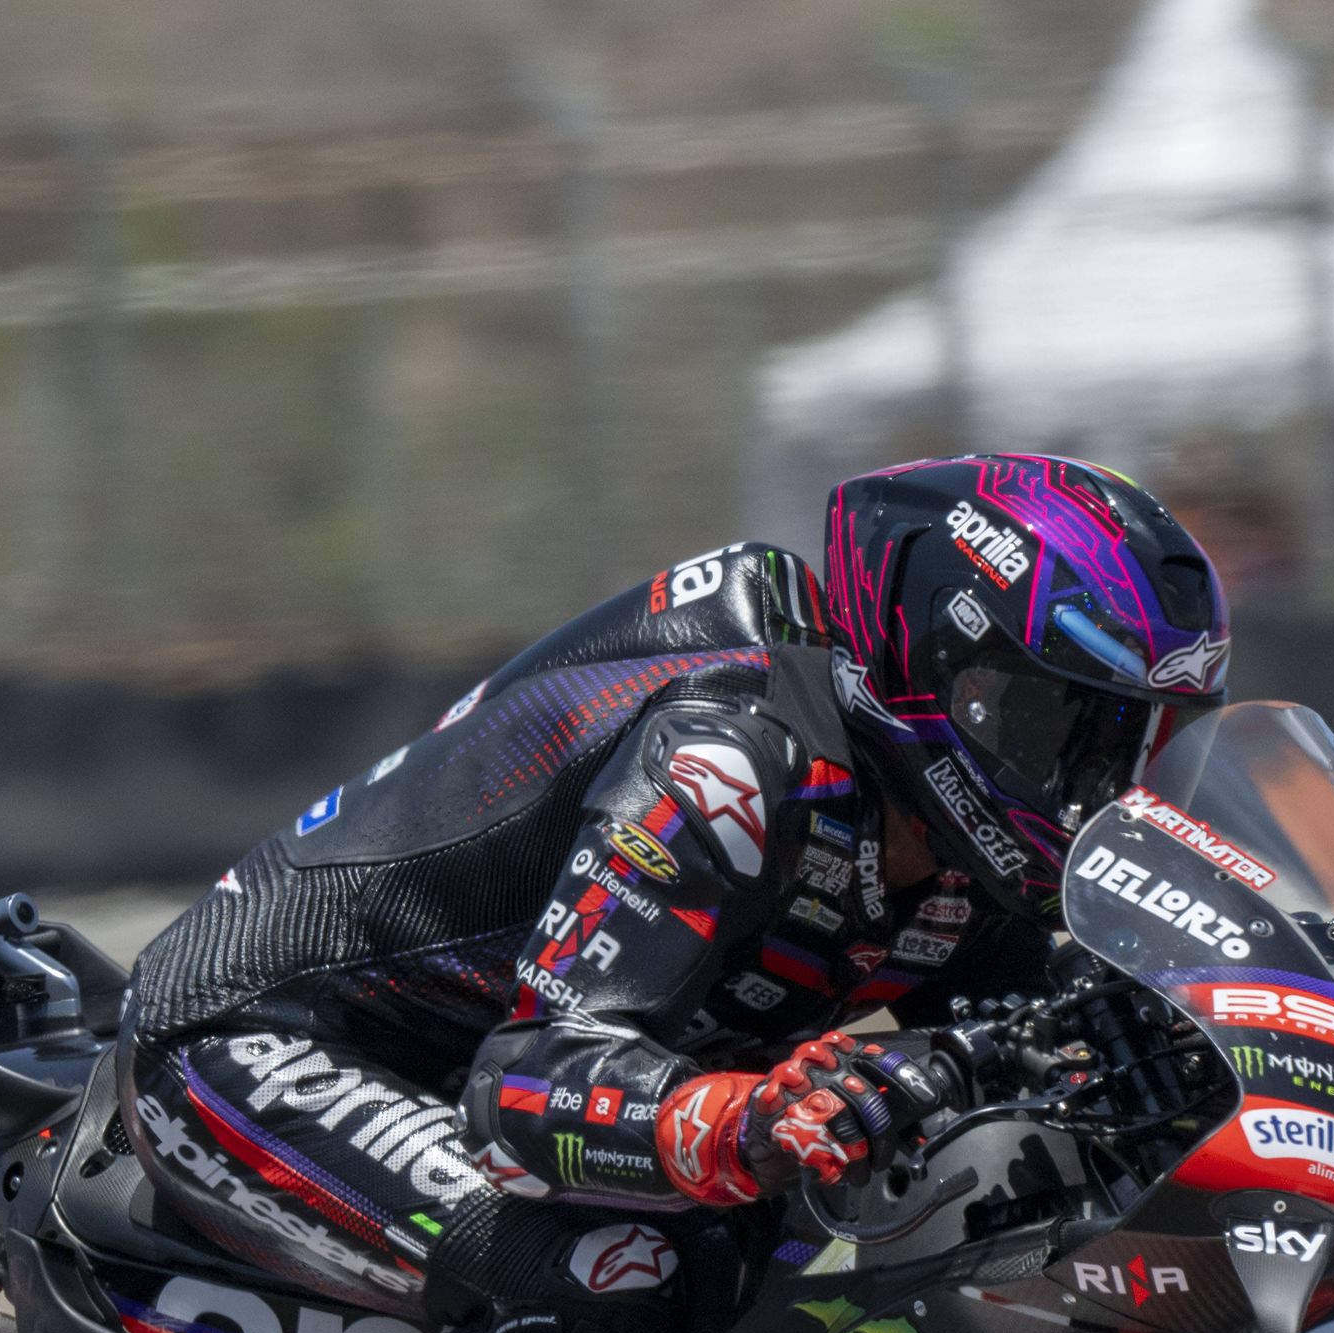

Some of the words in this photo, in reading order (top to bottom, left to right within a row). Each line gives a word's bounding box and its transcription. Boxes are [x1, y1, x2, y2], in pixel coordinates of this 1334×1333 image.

[946, 500, 1029, 584] aprilia
[955, 537, 1010, 592] RACING
[954, 600, 984, 633] 100%
[588, 860, 661, 923] Lifenet.it
[855, 839, 887, 921] aprilia
[1075, 846, 1251, 960] DELLORTO
[228, 1032, 490, 1210] aprilia
[585, 1148, 654, 1171] MONSTER
[1232, 1221, 1327, 1263] sky
